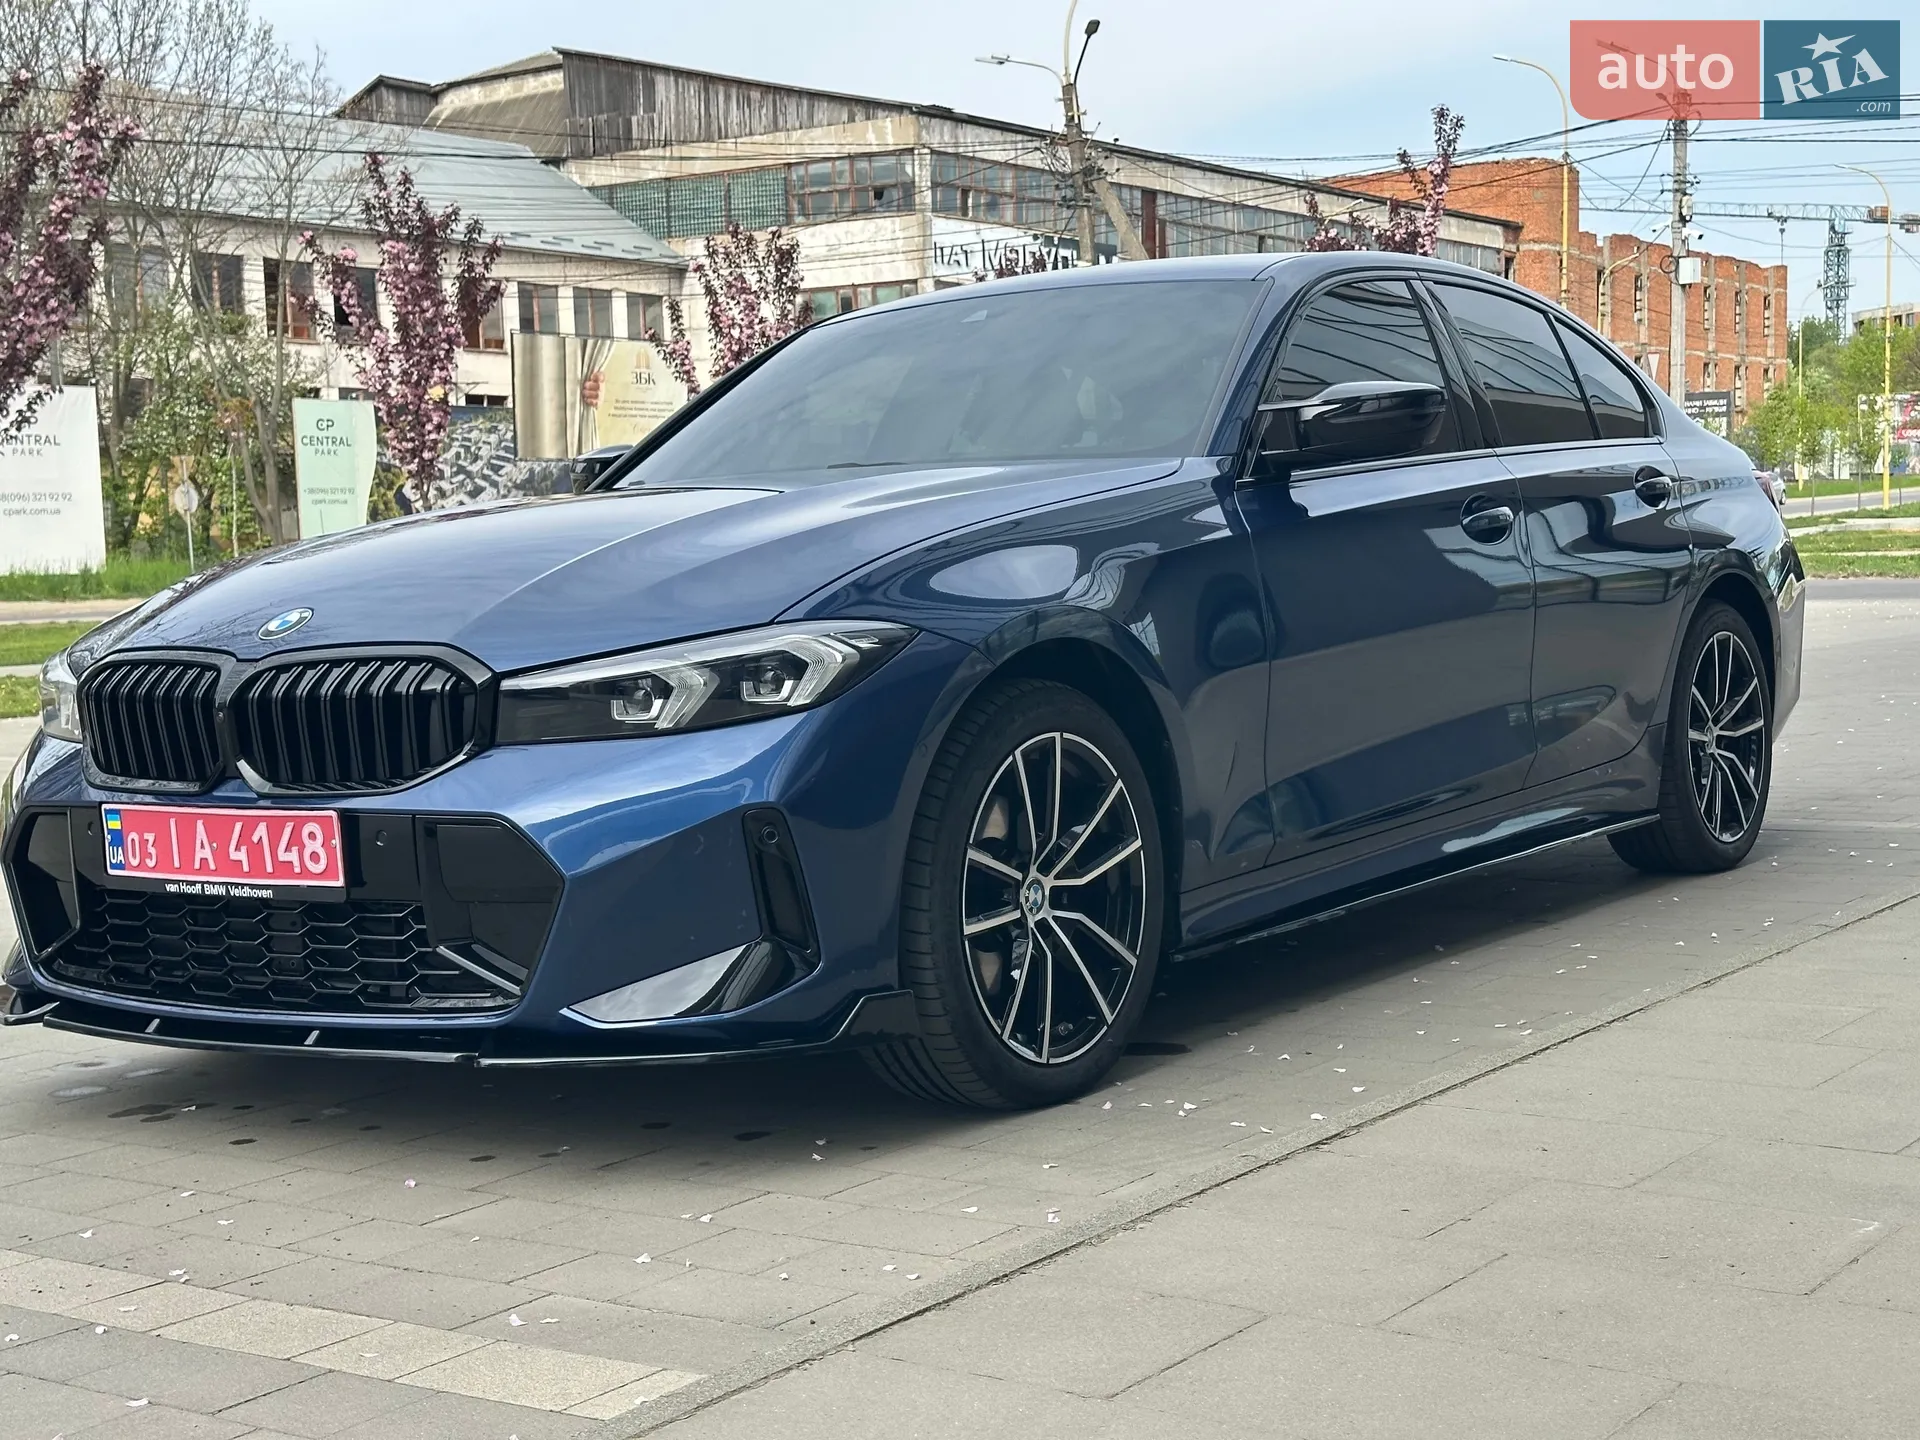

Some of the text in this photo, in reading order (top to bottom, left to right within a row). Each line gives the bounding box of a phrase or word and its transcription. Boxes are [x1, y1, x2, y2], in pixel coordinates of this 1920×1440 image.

[316, 418, 335, 431] CP
[0, 434, 61, 446] ENTRAL
[301, 435, 352, 447] CENTRAL
[12, 447, 43, 457] PARK
[314, 448, 339, 456] PARK
[31, 491, 46, 502] 321
[48, 491, 59, 502] 92
[61, 491, 73, 502] 92
[3, 506, 61, 518] cpark.com.ua
[126, 817, 328, 875] 03 IA 4148
[109, 845, 125, 865] UA
[165, 882, 273, 898] van Hooff BMW Veldhoven
